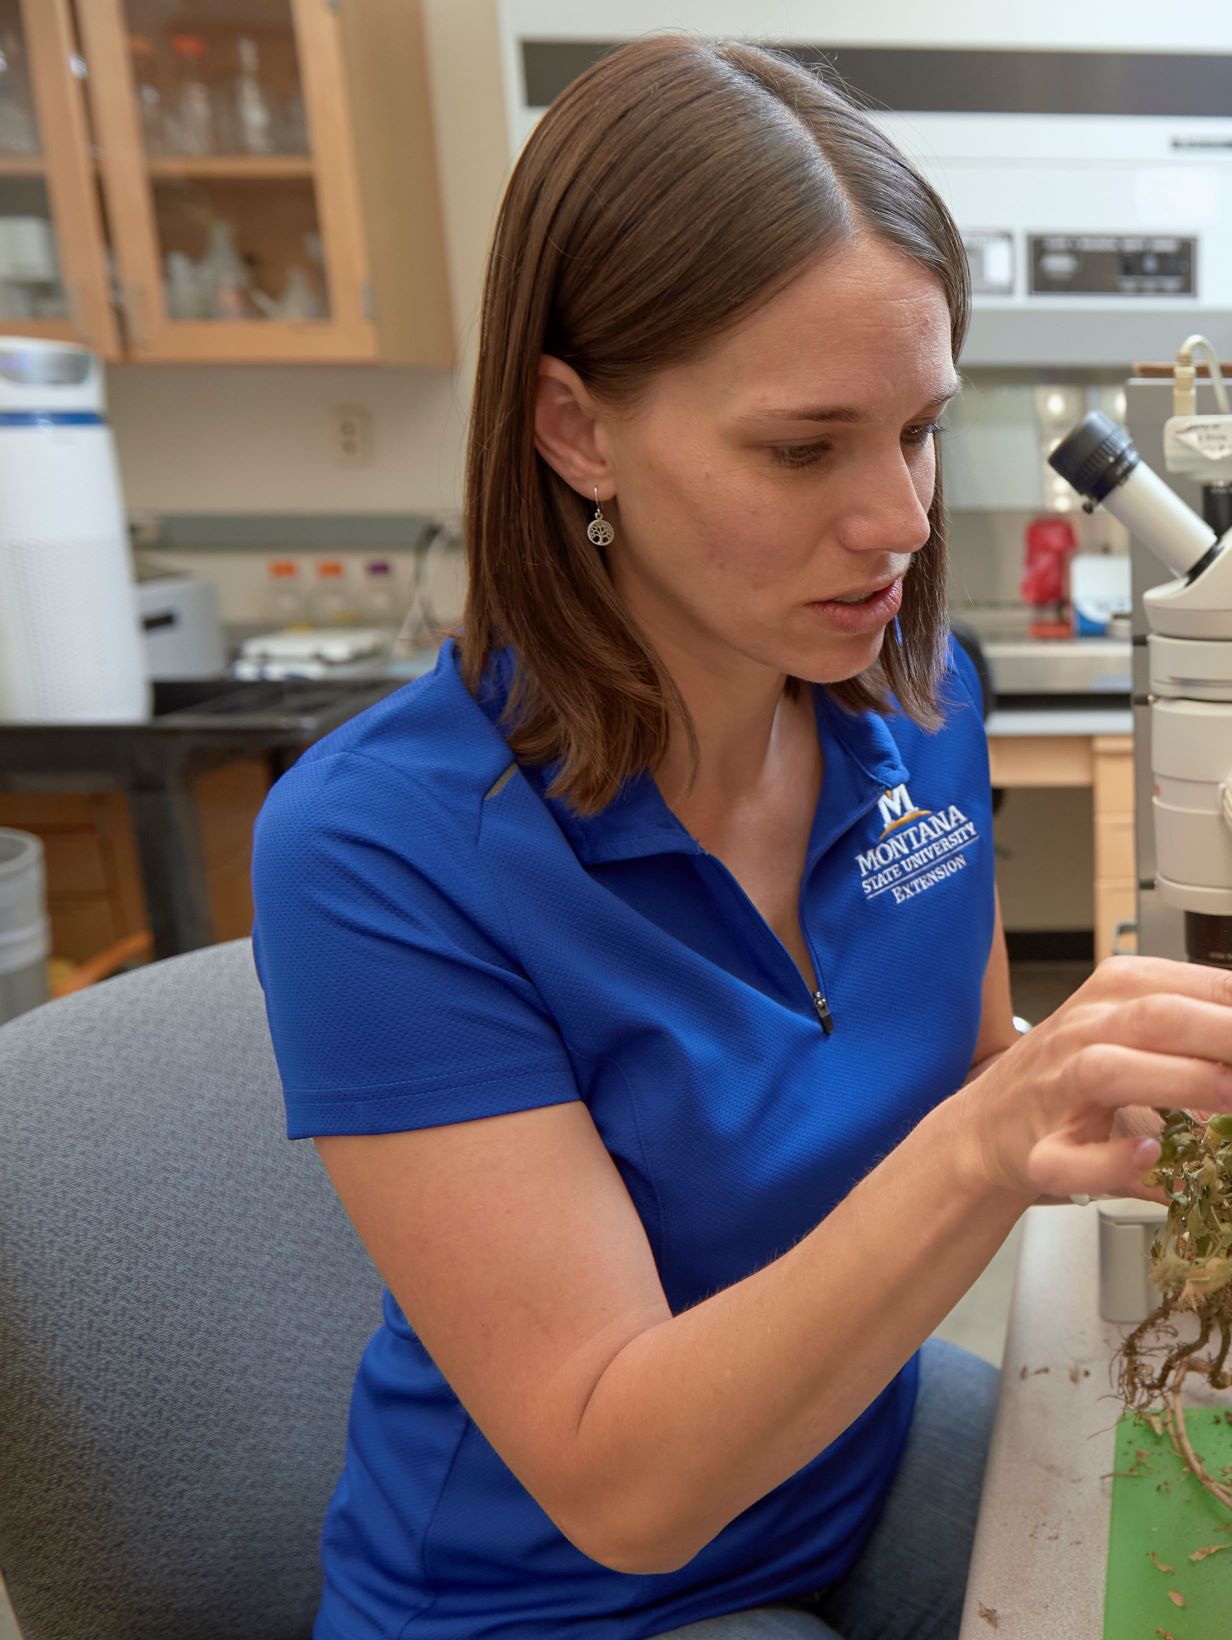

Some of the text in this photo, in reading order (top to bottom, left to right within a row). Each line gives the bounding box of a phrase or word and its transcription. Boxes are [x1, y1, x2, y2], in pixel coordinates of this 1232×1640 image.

[877, 783, 919, 828] M
[855, 804, 968, 878] MONTANA
[862, 822, 977, 894] STATE UNIVERSITY
[891, 854, 968, 904] EXTENSION
